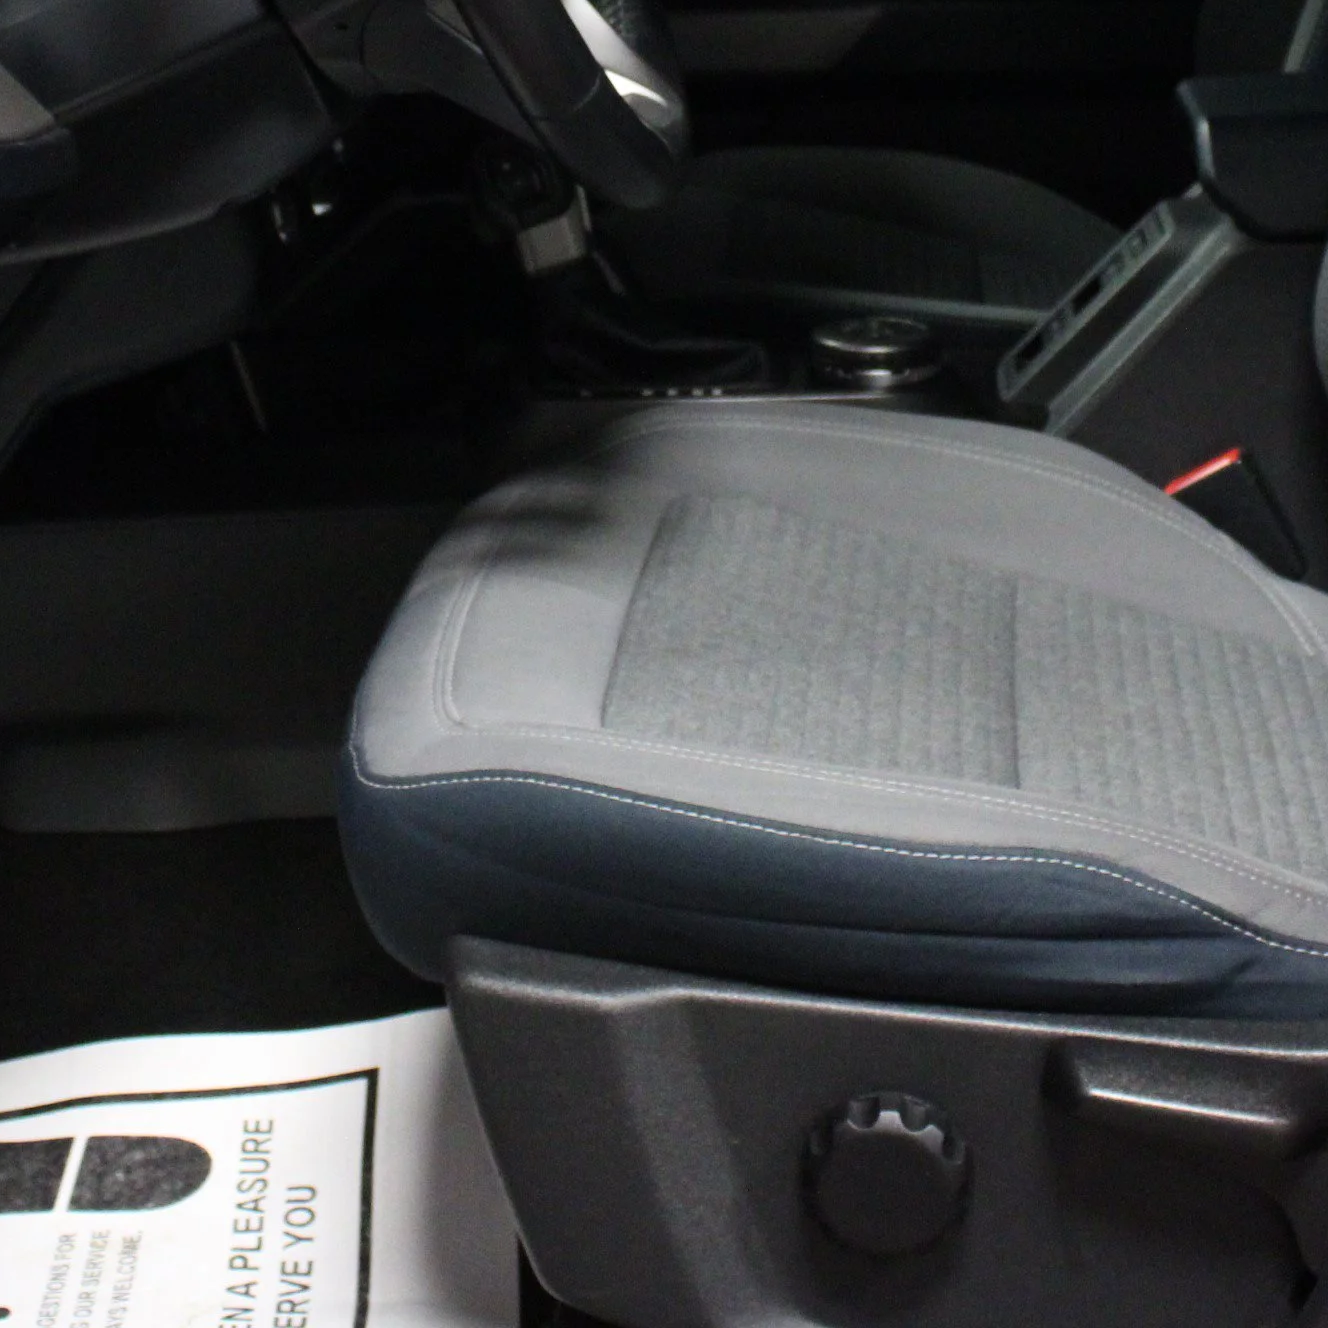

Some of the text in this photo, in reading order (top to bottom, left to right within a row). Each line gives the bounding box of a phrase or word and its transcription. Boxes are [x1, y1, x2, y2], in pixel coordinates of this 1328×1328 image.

[228, 1119, 273, 1271] PLEASURE
[54, 1232, 76, 1262] FOR
[80, 1229, 110, 1287] SERVICE
[111, 1230, 143, 1305] WELCOME.
[273, 1185, 317, 1328] ERVE YOU
[73, 1290, 97, 1319] OUR
[225, 1280, 258, 1298] A
